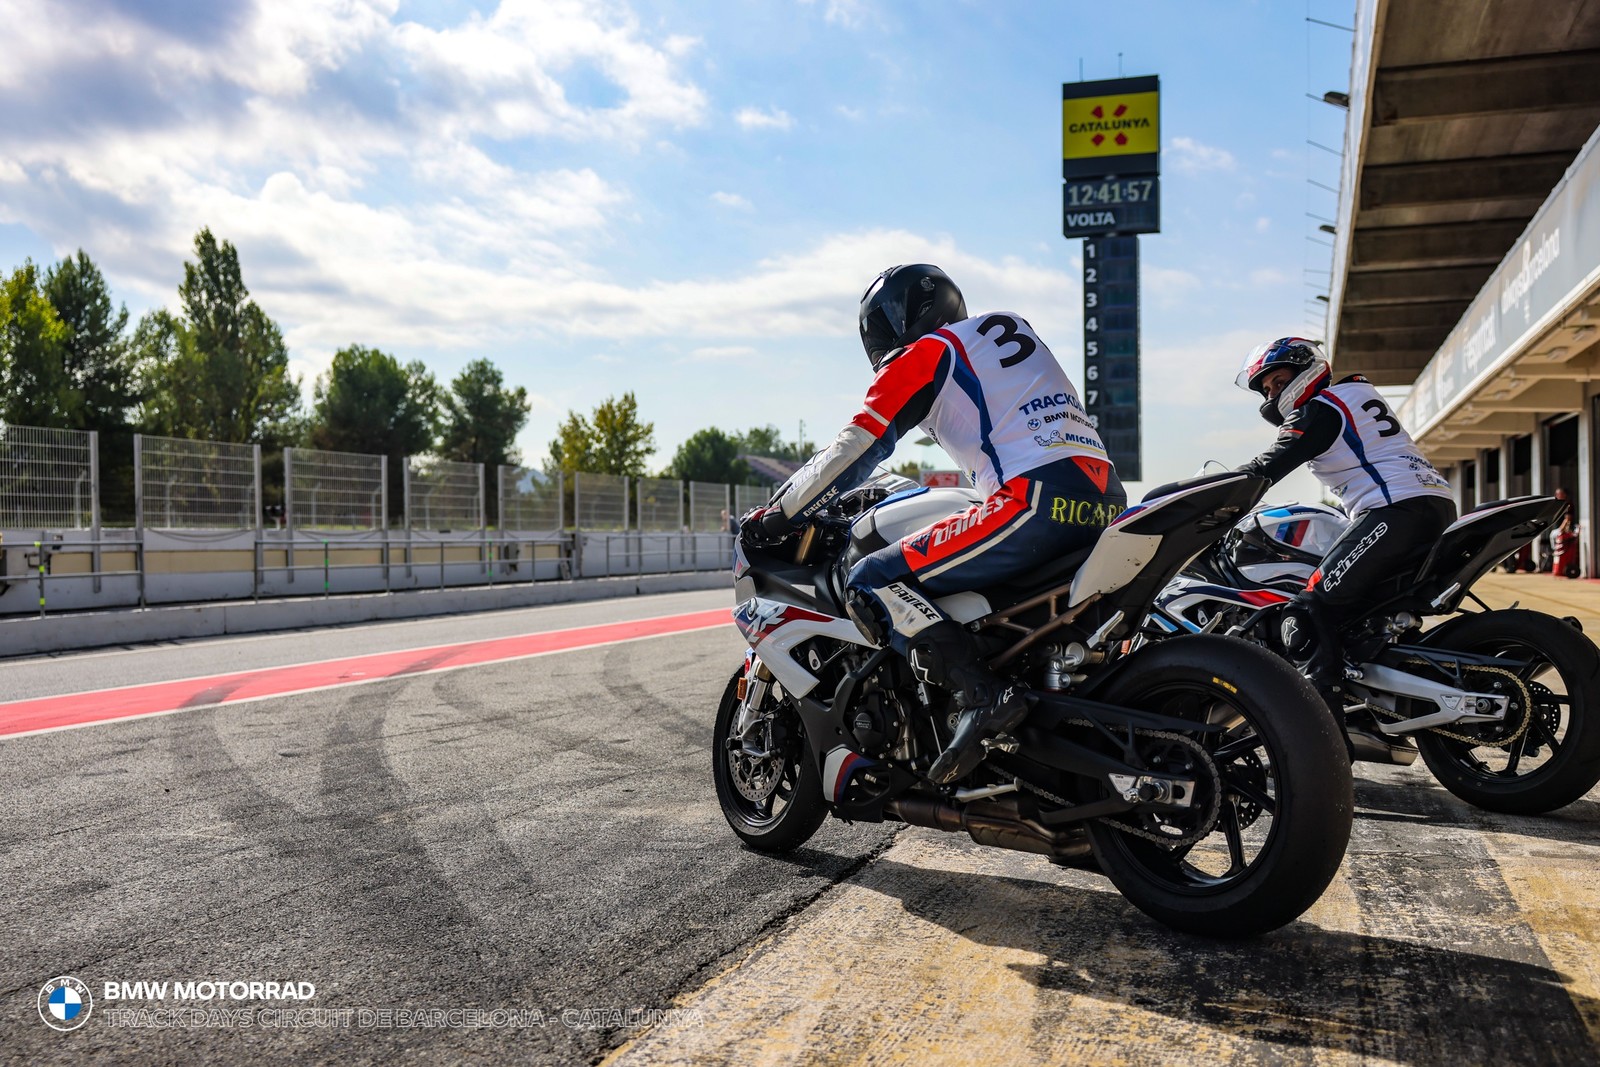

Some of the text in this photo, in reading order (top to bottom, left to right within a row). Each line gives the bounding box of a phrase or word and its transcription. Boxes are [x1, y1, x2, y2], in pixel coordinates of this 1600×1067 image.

[1069, 118, 1150, 133] CATALUNYA
[1068, 180, 1152, 206] 12:41:57
[1066, 212, 1115, 227] VOLTA
[1086, 244, 1095, 258] 1
[1086, 268, 1097, 283] 2
[1086, 293, 1097, 308] 3
[1086, 317, 1098, 332] 4
[976, 314, 1036, 368] 3
[1087, 341, 1098, 356] 5
[1087, 365, 1098, 380] 6
[1087, 390, 1098, 405] 7
[1043, 411, 1069, 424] BMW
[1361, 399, 1400, 438] 3
[1323, 522, 1388, 592] alpinestars
